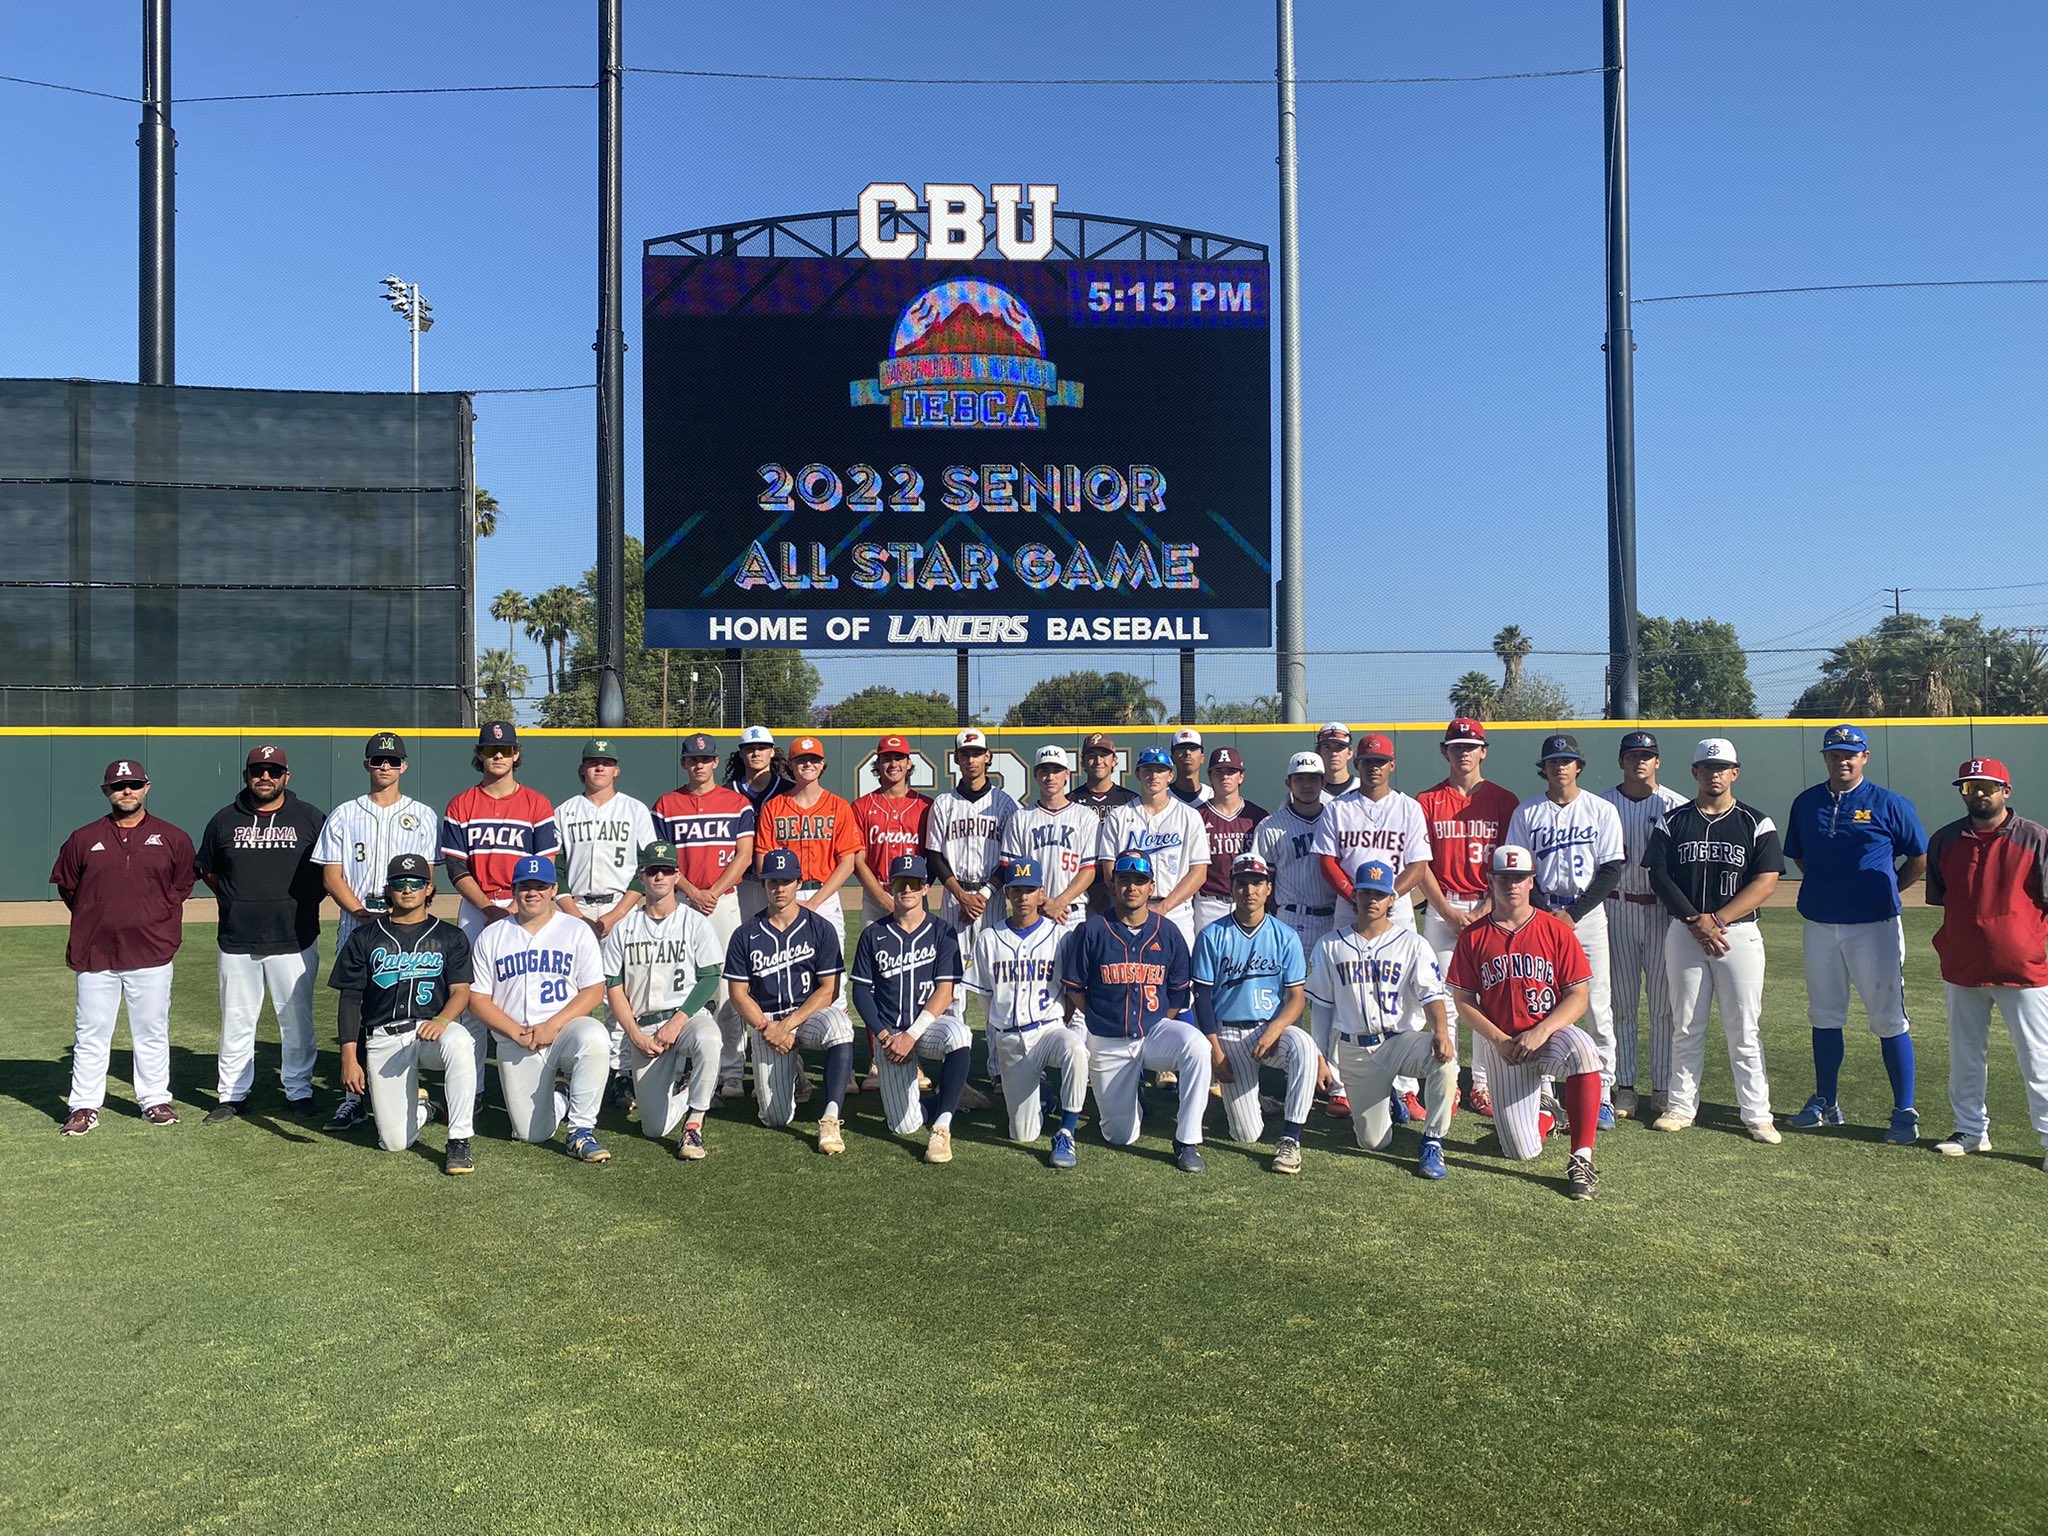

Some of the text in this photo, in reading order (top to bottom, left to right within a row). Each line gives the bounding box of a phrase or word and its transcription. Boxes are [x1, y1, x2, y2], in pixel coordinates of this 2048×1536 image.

[858, 182, 1058, 260] CBU
[1088, 282, 1251, 312] 5:15 PM
[903, 390, 1040, 426] IEBCA
[757, 462, 1167, 513] 2022 SENIOR
[734, 539, 1200, 591] ALL STAR GAME
[709, 615, 1209, 643] HOME OF LANCERS BASEBALL
[261, 746, 275, 759] P
[379, 737, 395, 750] M
[887, 737, 901, 747] C
[1041, 750, 1060, 759] MLK
[1218, 750, 1231, 762] A
[1296, 758, 1317, 767] MLK
[116, 762, 132, 776] A
[1969, 761, 1984, 774] H
[234, 827, 298, 842] PALOMA
[468, 827, 525, 848] PACK
[568, 820, 630, 844] TITANS
[674, 820, 731, 841] PACK
[775, 816, 835, 841] BEARS
[869, 825, 919, 845] Corona
[946, 818, 1000, 842] ARRIORS
[1032, 824, 1074, 851] MLK
[1126, 830, 1183, 850] Norco
[1433, 820, 1499, 839] BULLDOGS
[1530, 825, 1598, 852] Titans
[1339, 829, 1405, 852] HUSKIES
[355, 843, 366, 862] 3
[614, 847, 626, 868] 5
[718, 850, 735, 867] 24
[776, 856, 786, 870] B
[903, 856, 913, 869] B
[1061, 851, 1079, 872] 55
[1506, 852, 1519, 868] E
[1677, 841, 1746, 867] TIGERS
[528, 860, 539, 873] B
[1015, 864, 1031, 877] M
[1574, 855, 1584, 877] 2
[1719, 871, 1738, 897] 11
[370, 947, 443, 973] Canyon
[496, 949, 573, 982] COUGARS
[750, 941, 813, 972] Broncos
[875, 944, 937, 972] Broncos
[1219, 949, 1281, 977] Huskies
[673, 968, 685, 992] 2
[801, 971, 811, 994] 9
[993, 959, 1055, 984] VIKINGS
[1336, 960, 1402, 986] VIKINGS
[415, 981, 435, 1006] 5
[540, 979, 568, 1004] 20
[1038, 989, 1050, 1011] 2
[1144, 986, 1159, 1012] 5
[1253, 988, 1274, 1012] 15
[1526, 987, 1556, 1015] 39
